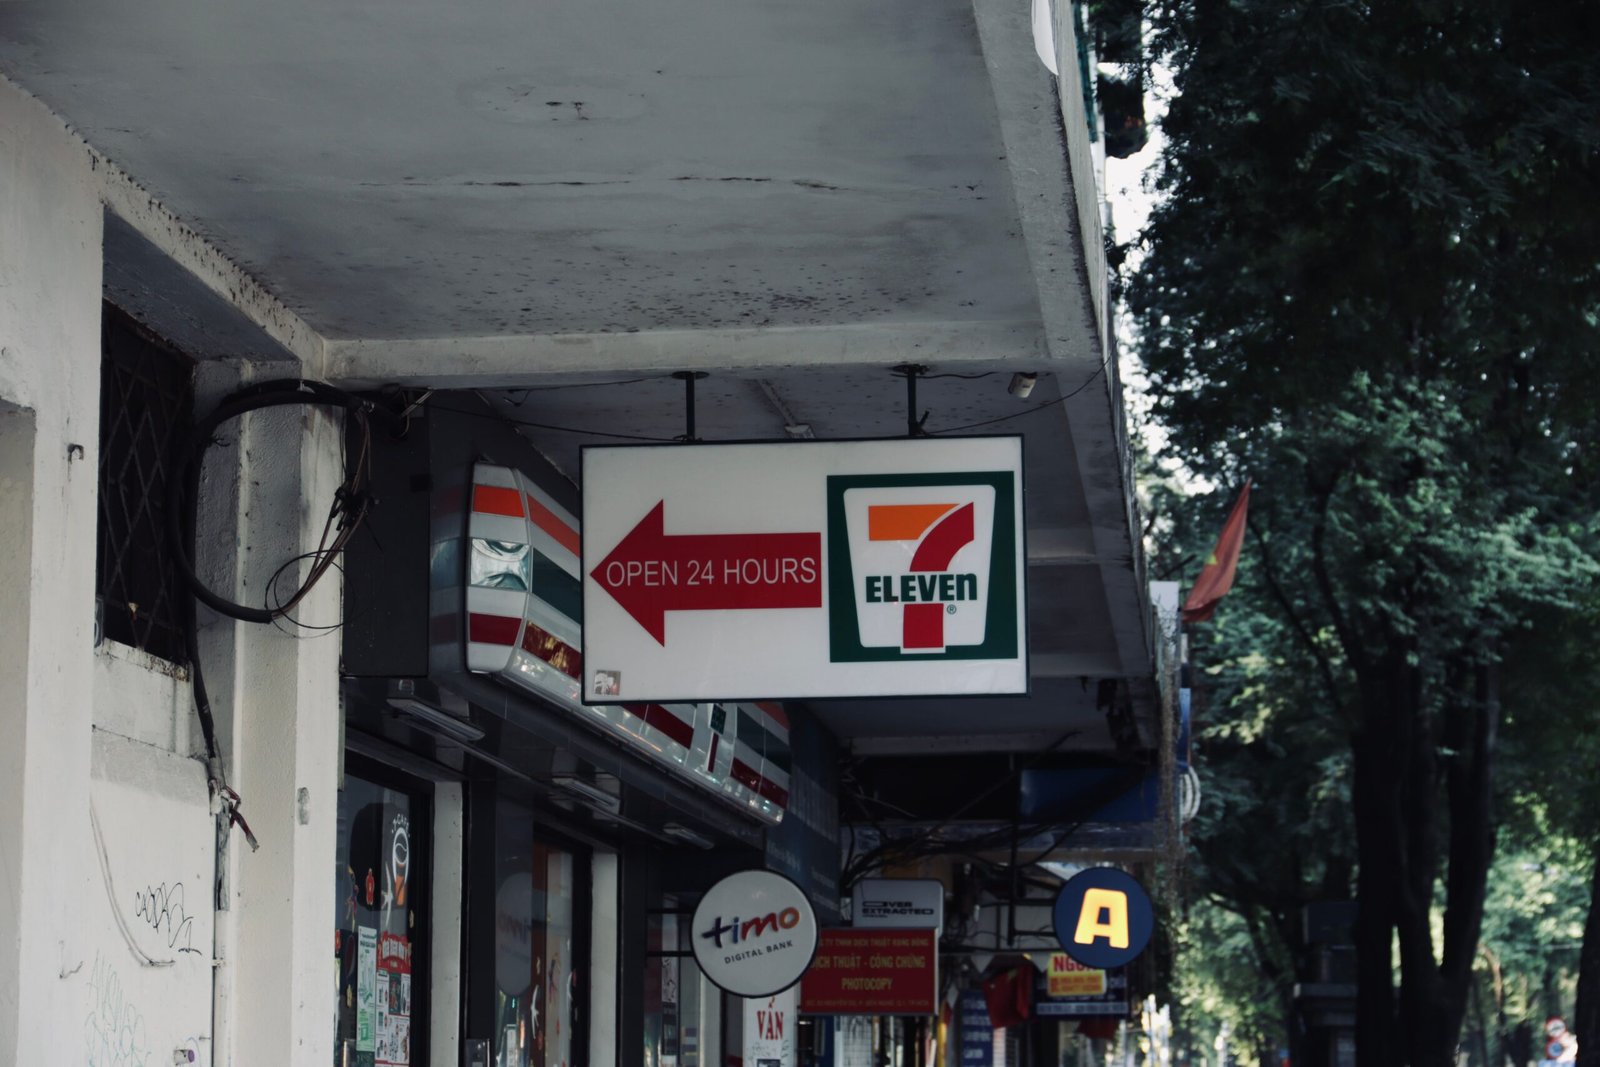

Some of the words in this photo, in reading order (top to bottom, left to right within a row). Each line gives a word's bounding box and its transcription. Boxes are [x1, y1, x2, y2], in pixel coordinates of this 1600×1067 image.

[606, 561, 679, 587] OPEN
[686, 560, 713, 584] 24
[723, 557, 817, 584] HOURS
[862, 908, 934, 916] EXTRACTED
[1074, 888, 1129, 949] A
[702, 907, 800, 948] timo
[724, 948, 764, 964] DIGITAL
[766, 940, 794, 953] BANK
[833, 953, 861, 970] THUẬT
[869, 953, 893, 968] CÔNG
[841, 977, 893, 990] PHOTOCOPY
